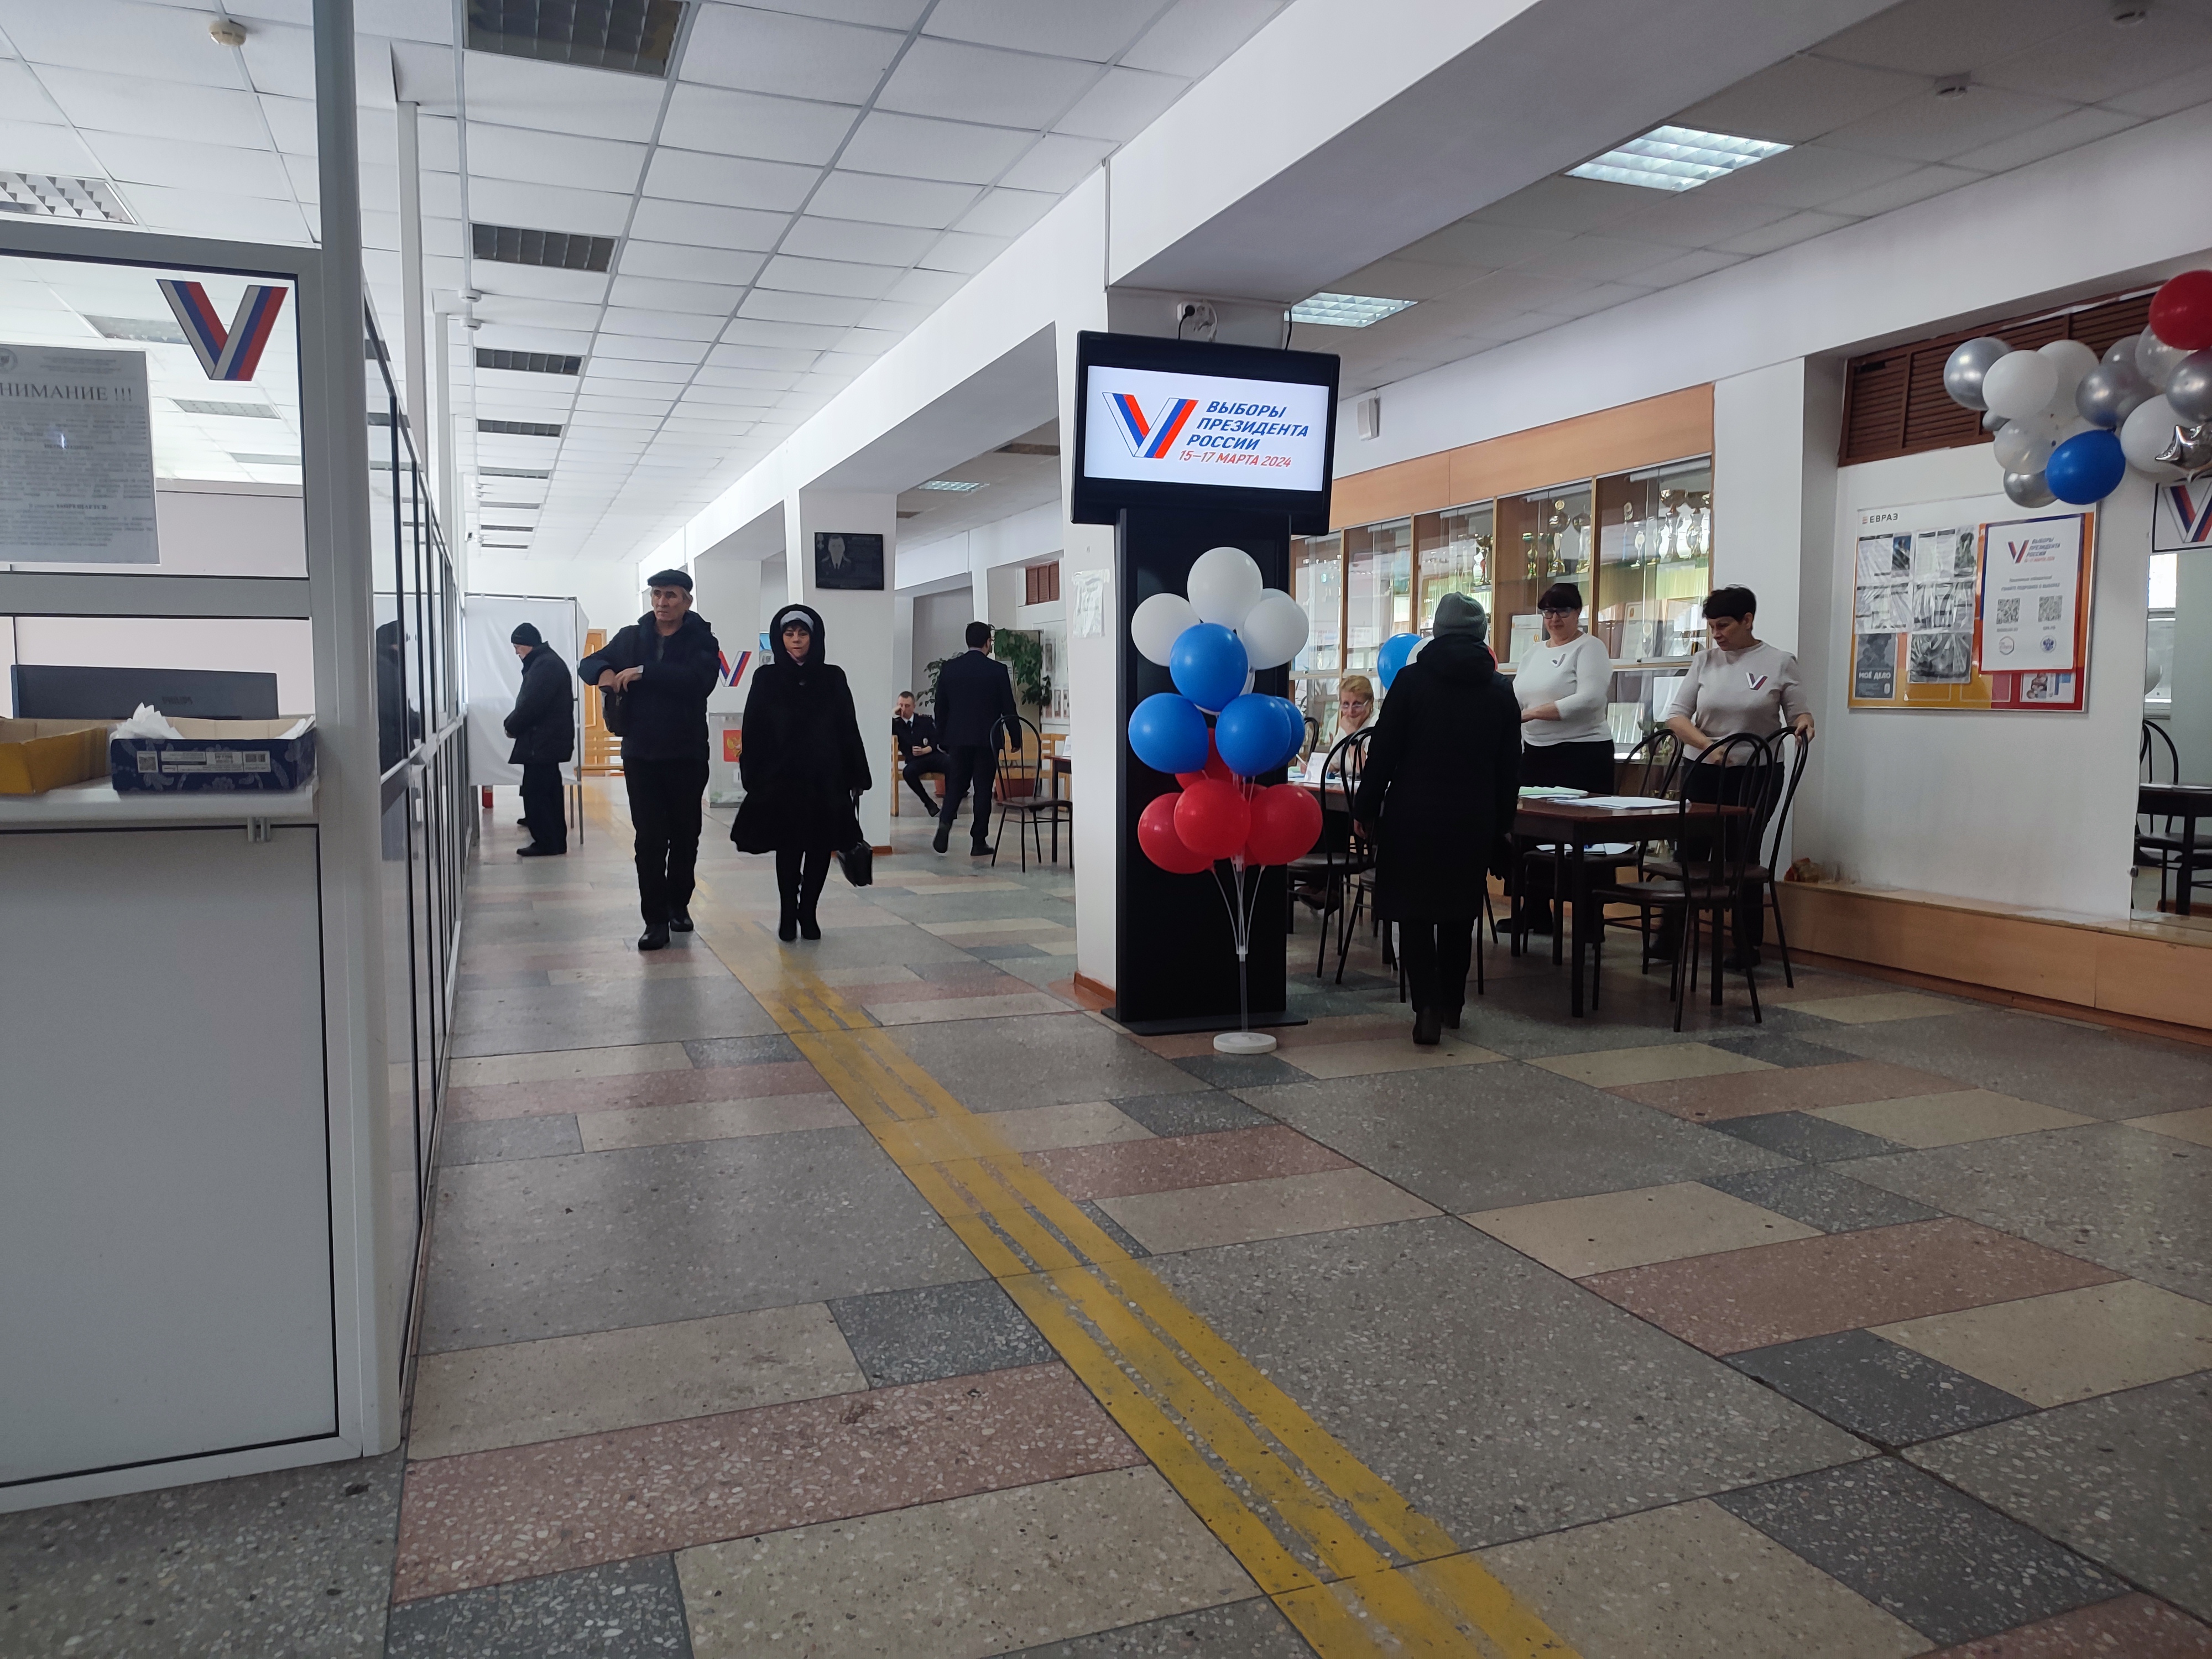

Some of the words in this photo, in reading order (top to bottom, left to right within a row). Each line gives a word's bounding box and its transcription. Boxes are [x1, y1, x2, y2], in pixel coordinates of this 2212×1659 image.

[1206, 401, 1287, 418] ВЫБОРЫ
[1196, 418, 1309, 437] ПРЕЗИДЕНТА
[1186, 434, 1261, 451] РОССИИ
[1215, 452, 1260, 466] МАРТА
[1260, 456, 1291, 468] 2024
[1870, 513, 1898, 523] ЕВРАЗ
